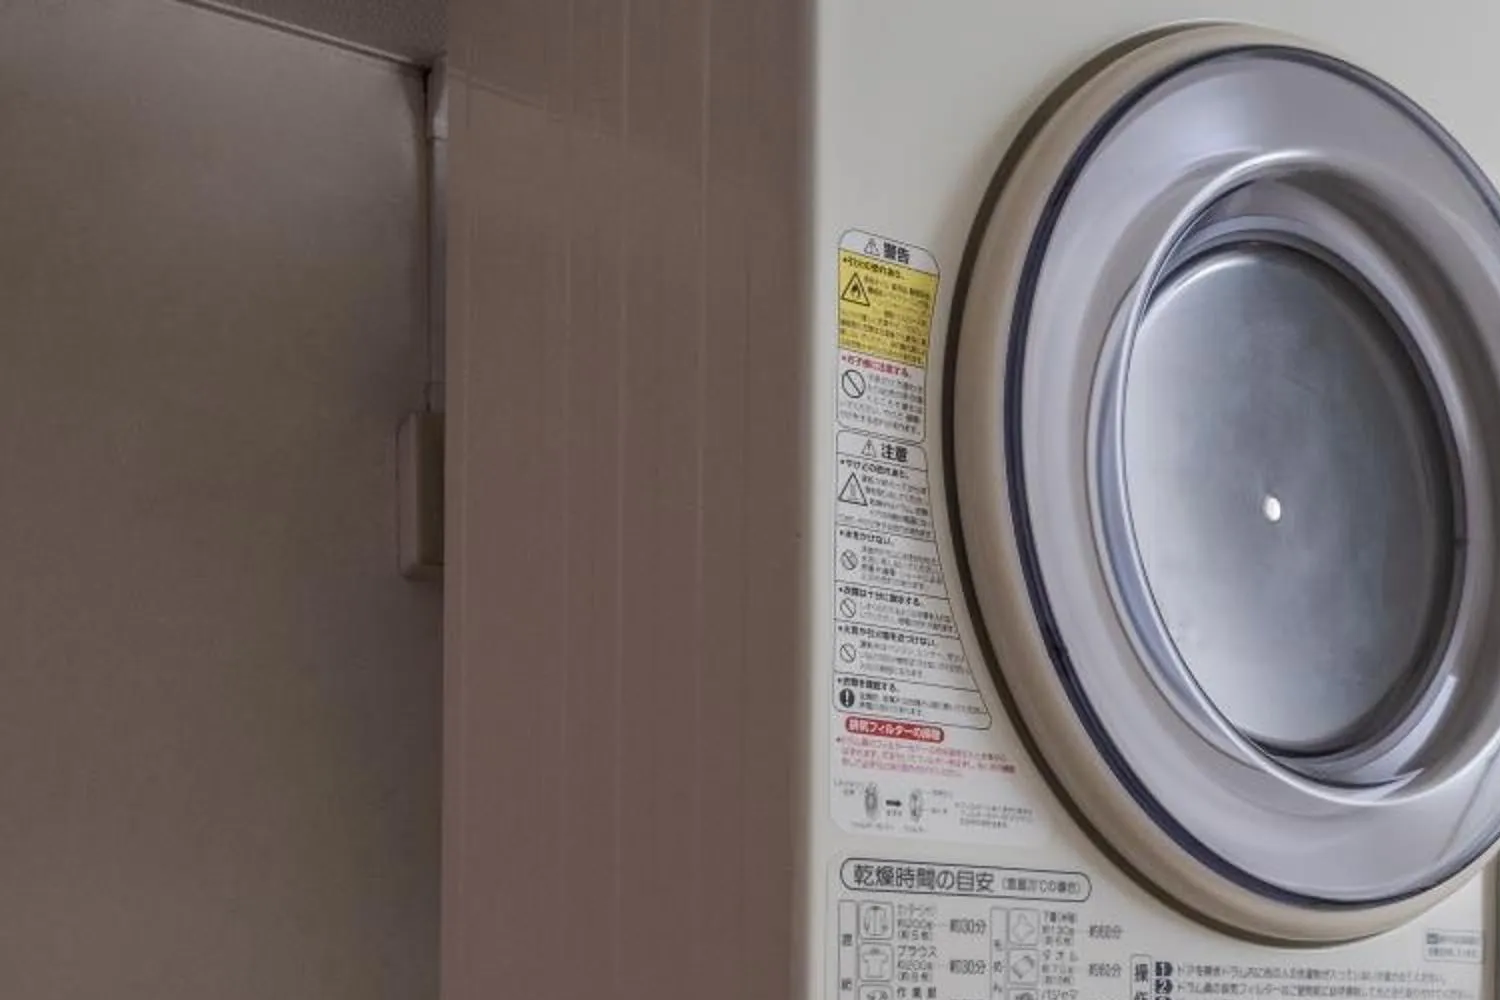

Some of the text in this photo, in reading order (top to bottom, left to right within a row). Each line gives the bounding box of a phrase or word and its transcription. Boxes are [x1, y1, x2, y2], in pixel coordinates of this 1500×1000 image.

[881, 442, 908, 463] 注意
[853, 864, 995, 893] 乾燥時間の目安
